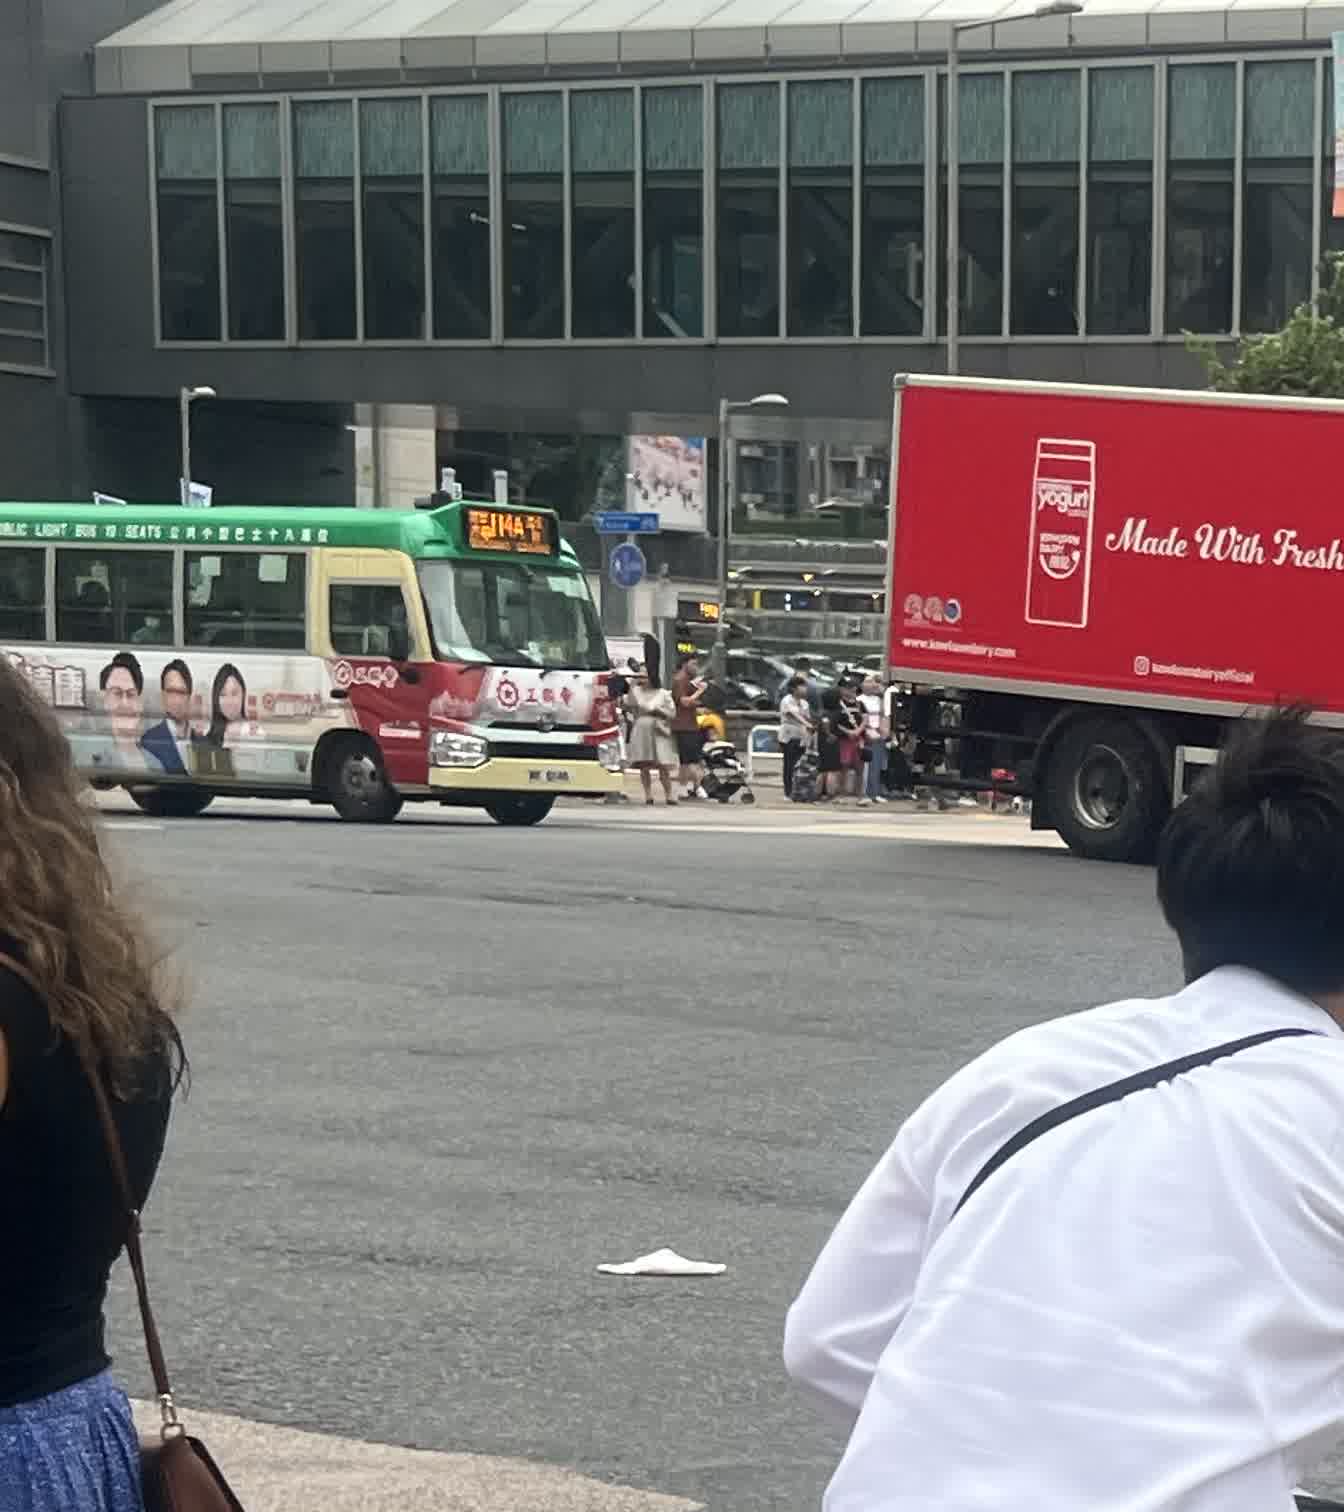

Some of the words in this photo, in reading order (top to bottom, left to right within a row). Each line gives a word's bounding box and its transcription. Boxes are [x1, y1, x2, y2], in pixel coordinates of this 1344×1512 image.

[1037, 488, 1090, 513] yogurt
[35, 522, 68, 537] LIGHT
[75, 524, 97, 538] BUS
[125, 525, 161, 539] SEATS
[1105, 517, 1188, 558] Made
[1195, 522, 1265, 565] With
